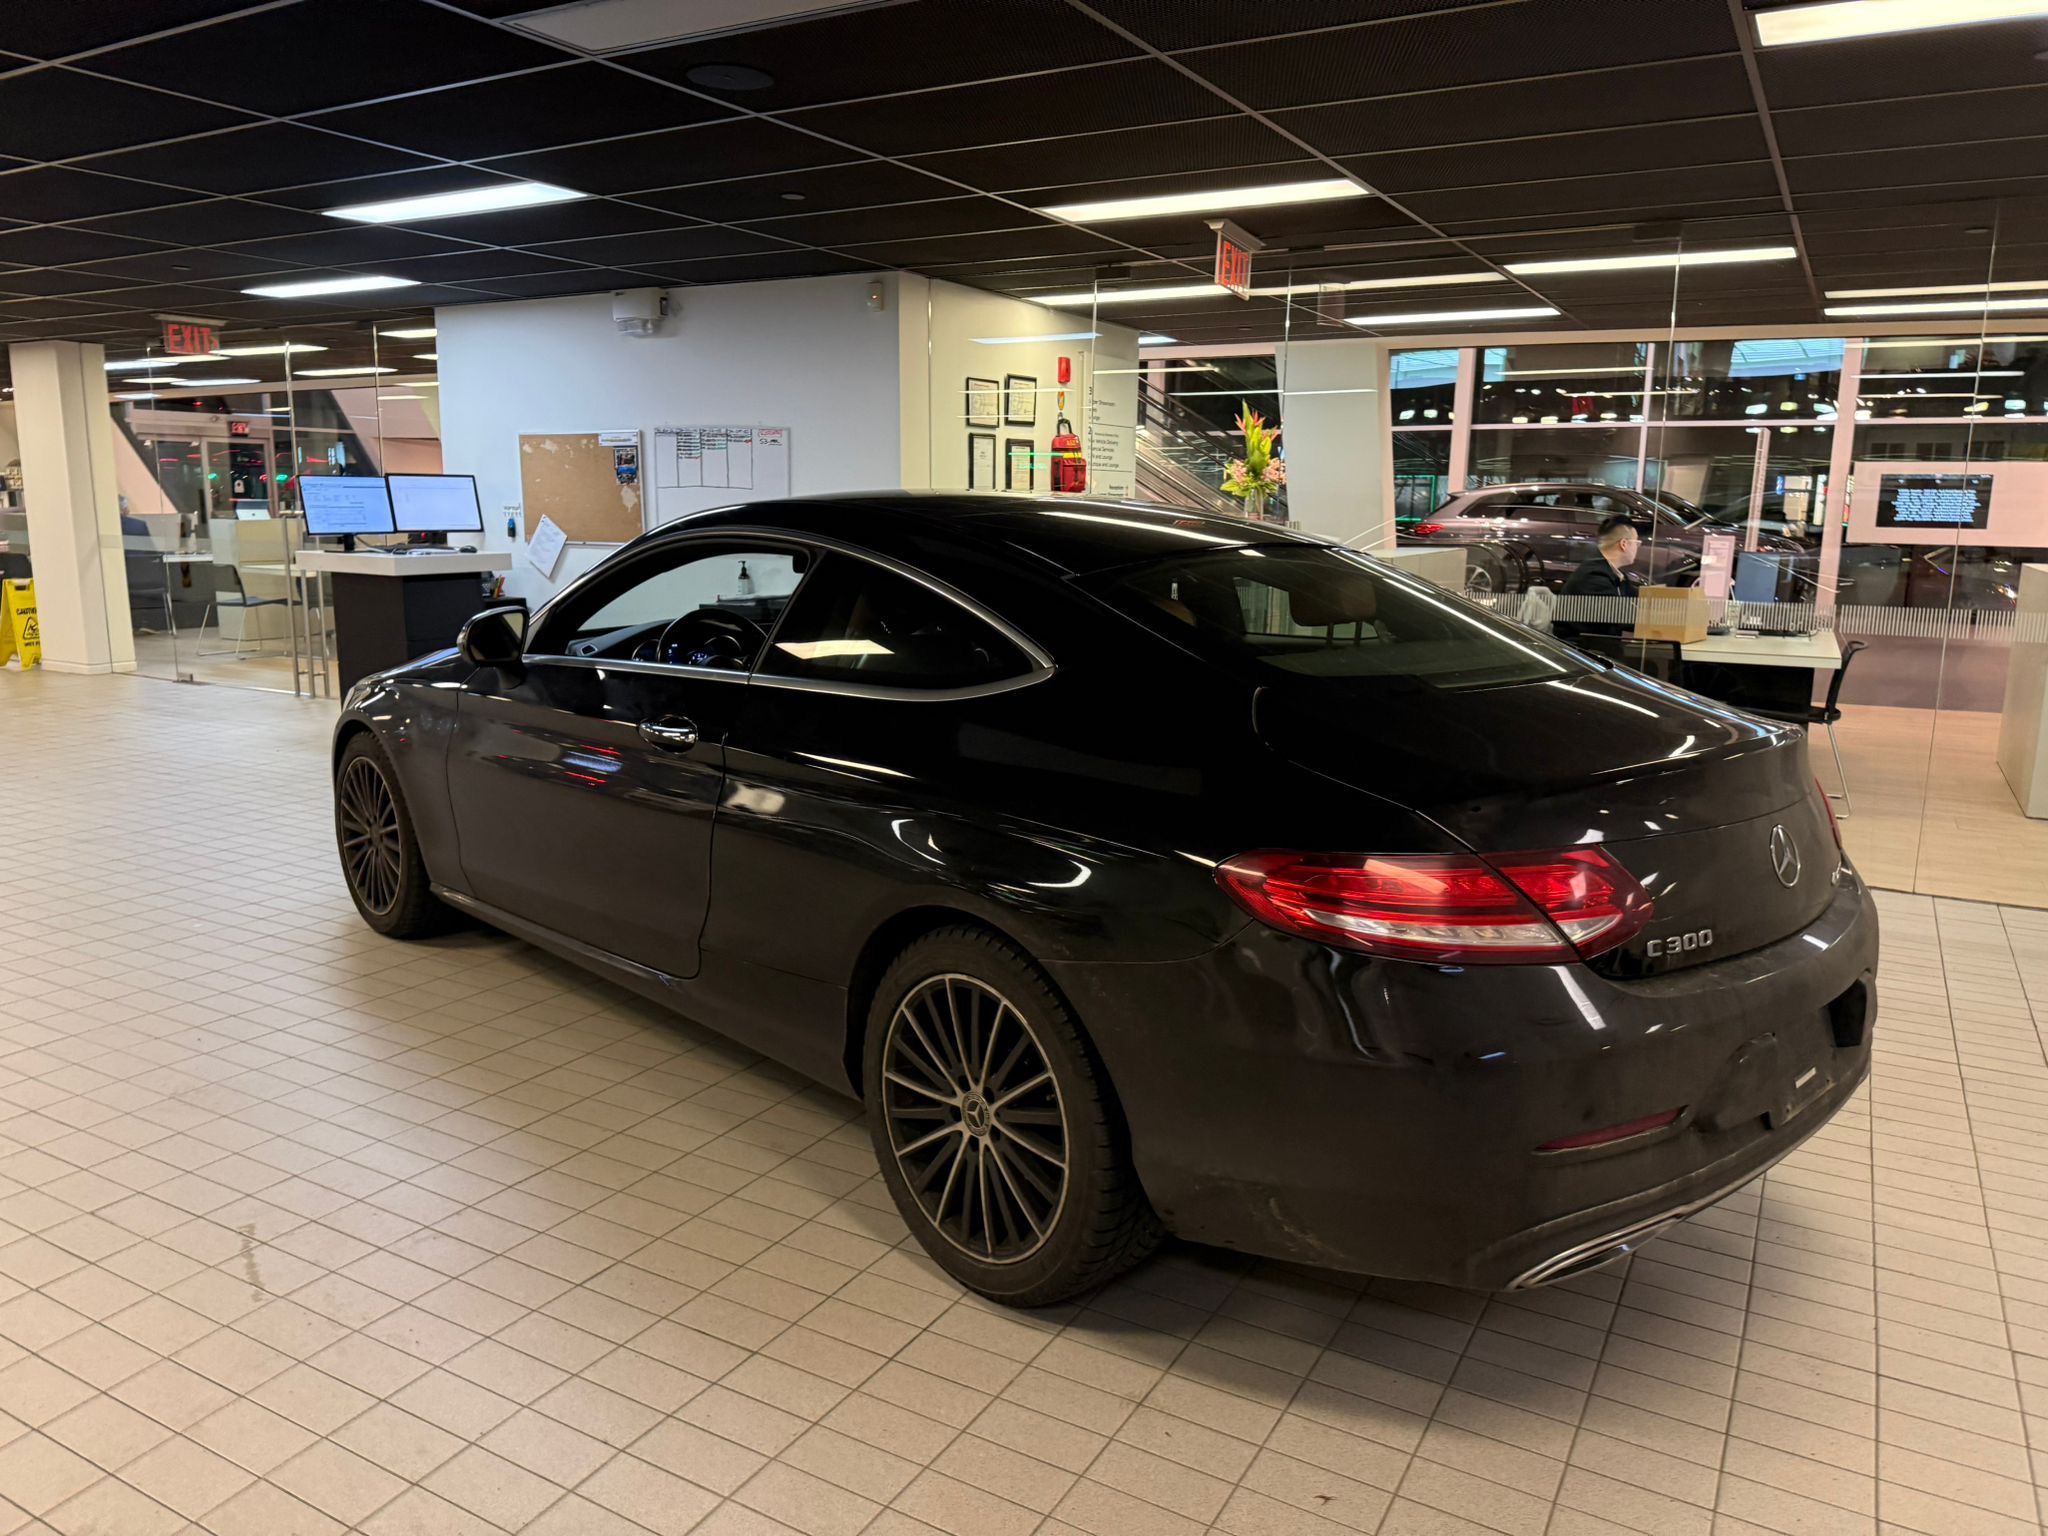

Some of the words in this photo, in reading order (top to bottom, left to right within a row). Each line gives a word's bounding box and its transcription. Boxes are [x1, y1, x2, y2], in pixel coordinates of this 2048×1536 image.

[1222, 241, 1249, 290] EXIT
[168, 324, 211, 352] EXIT
[1646, 939, 1663, 957] C
[1666, 929, 1713, 954] 300
